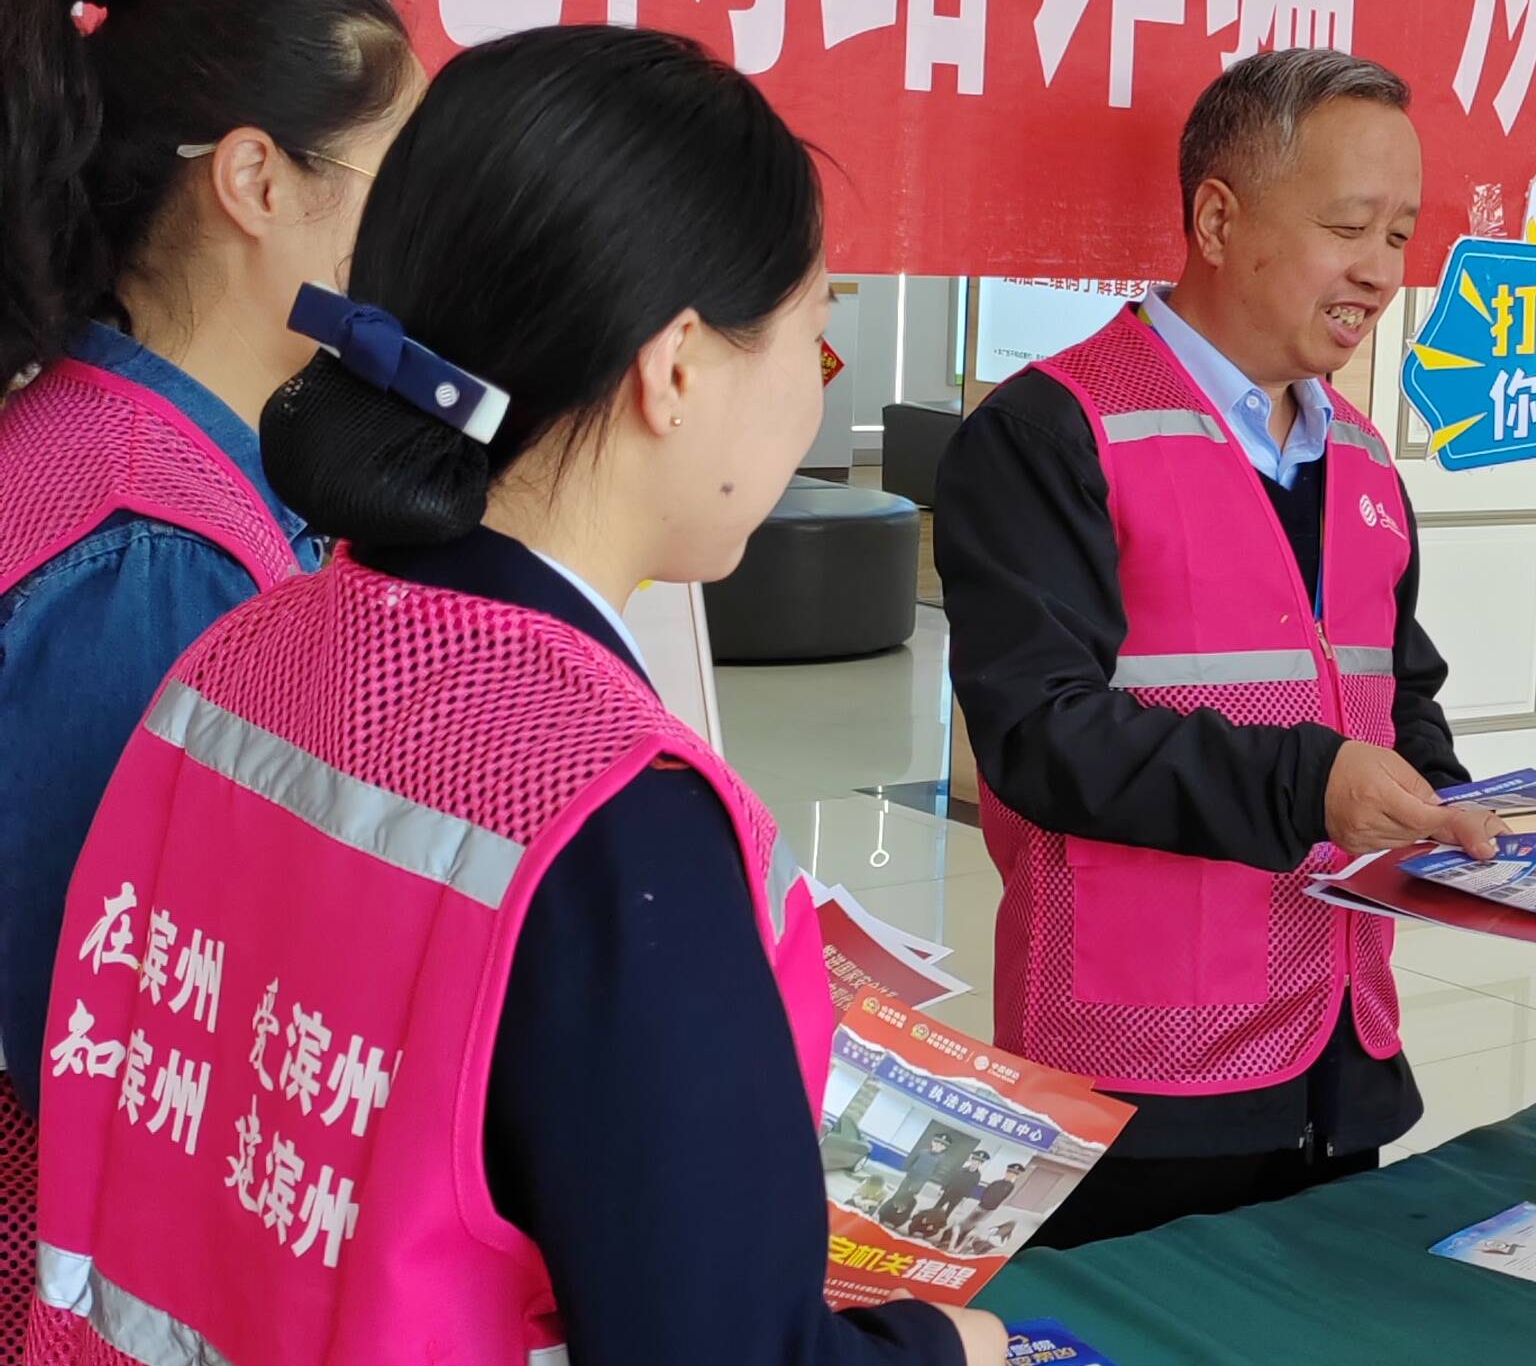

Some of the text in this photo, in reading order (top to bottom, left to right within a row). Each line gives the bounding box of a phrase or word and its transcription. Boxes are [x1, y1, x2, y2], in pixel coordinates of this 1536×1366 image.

[78, 882, 225, 1033] 在滨州
[50, 998, 212, 1155] 知滨州
[928, 1085, 1043, 1143] 执法办案管理中心
